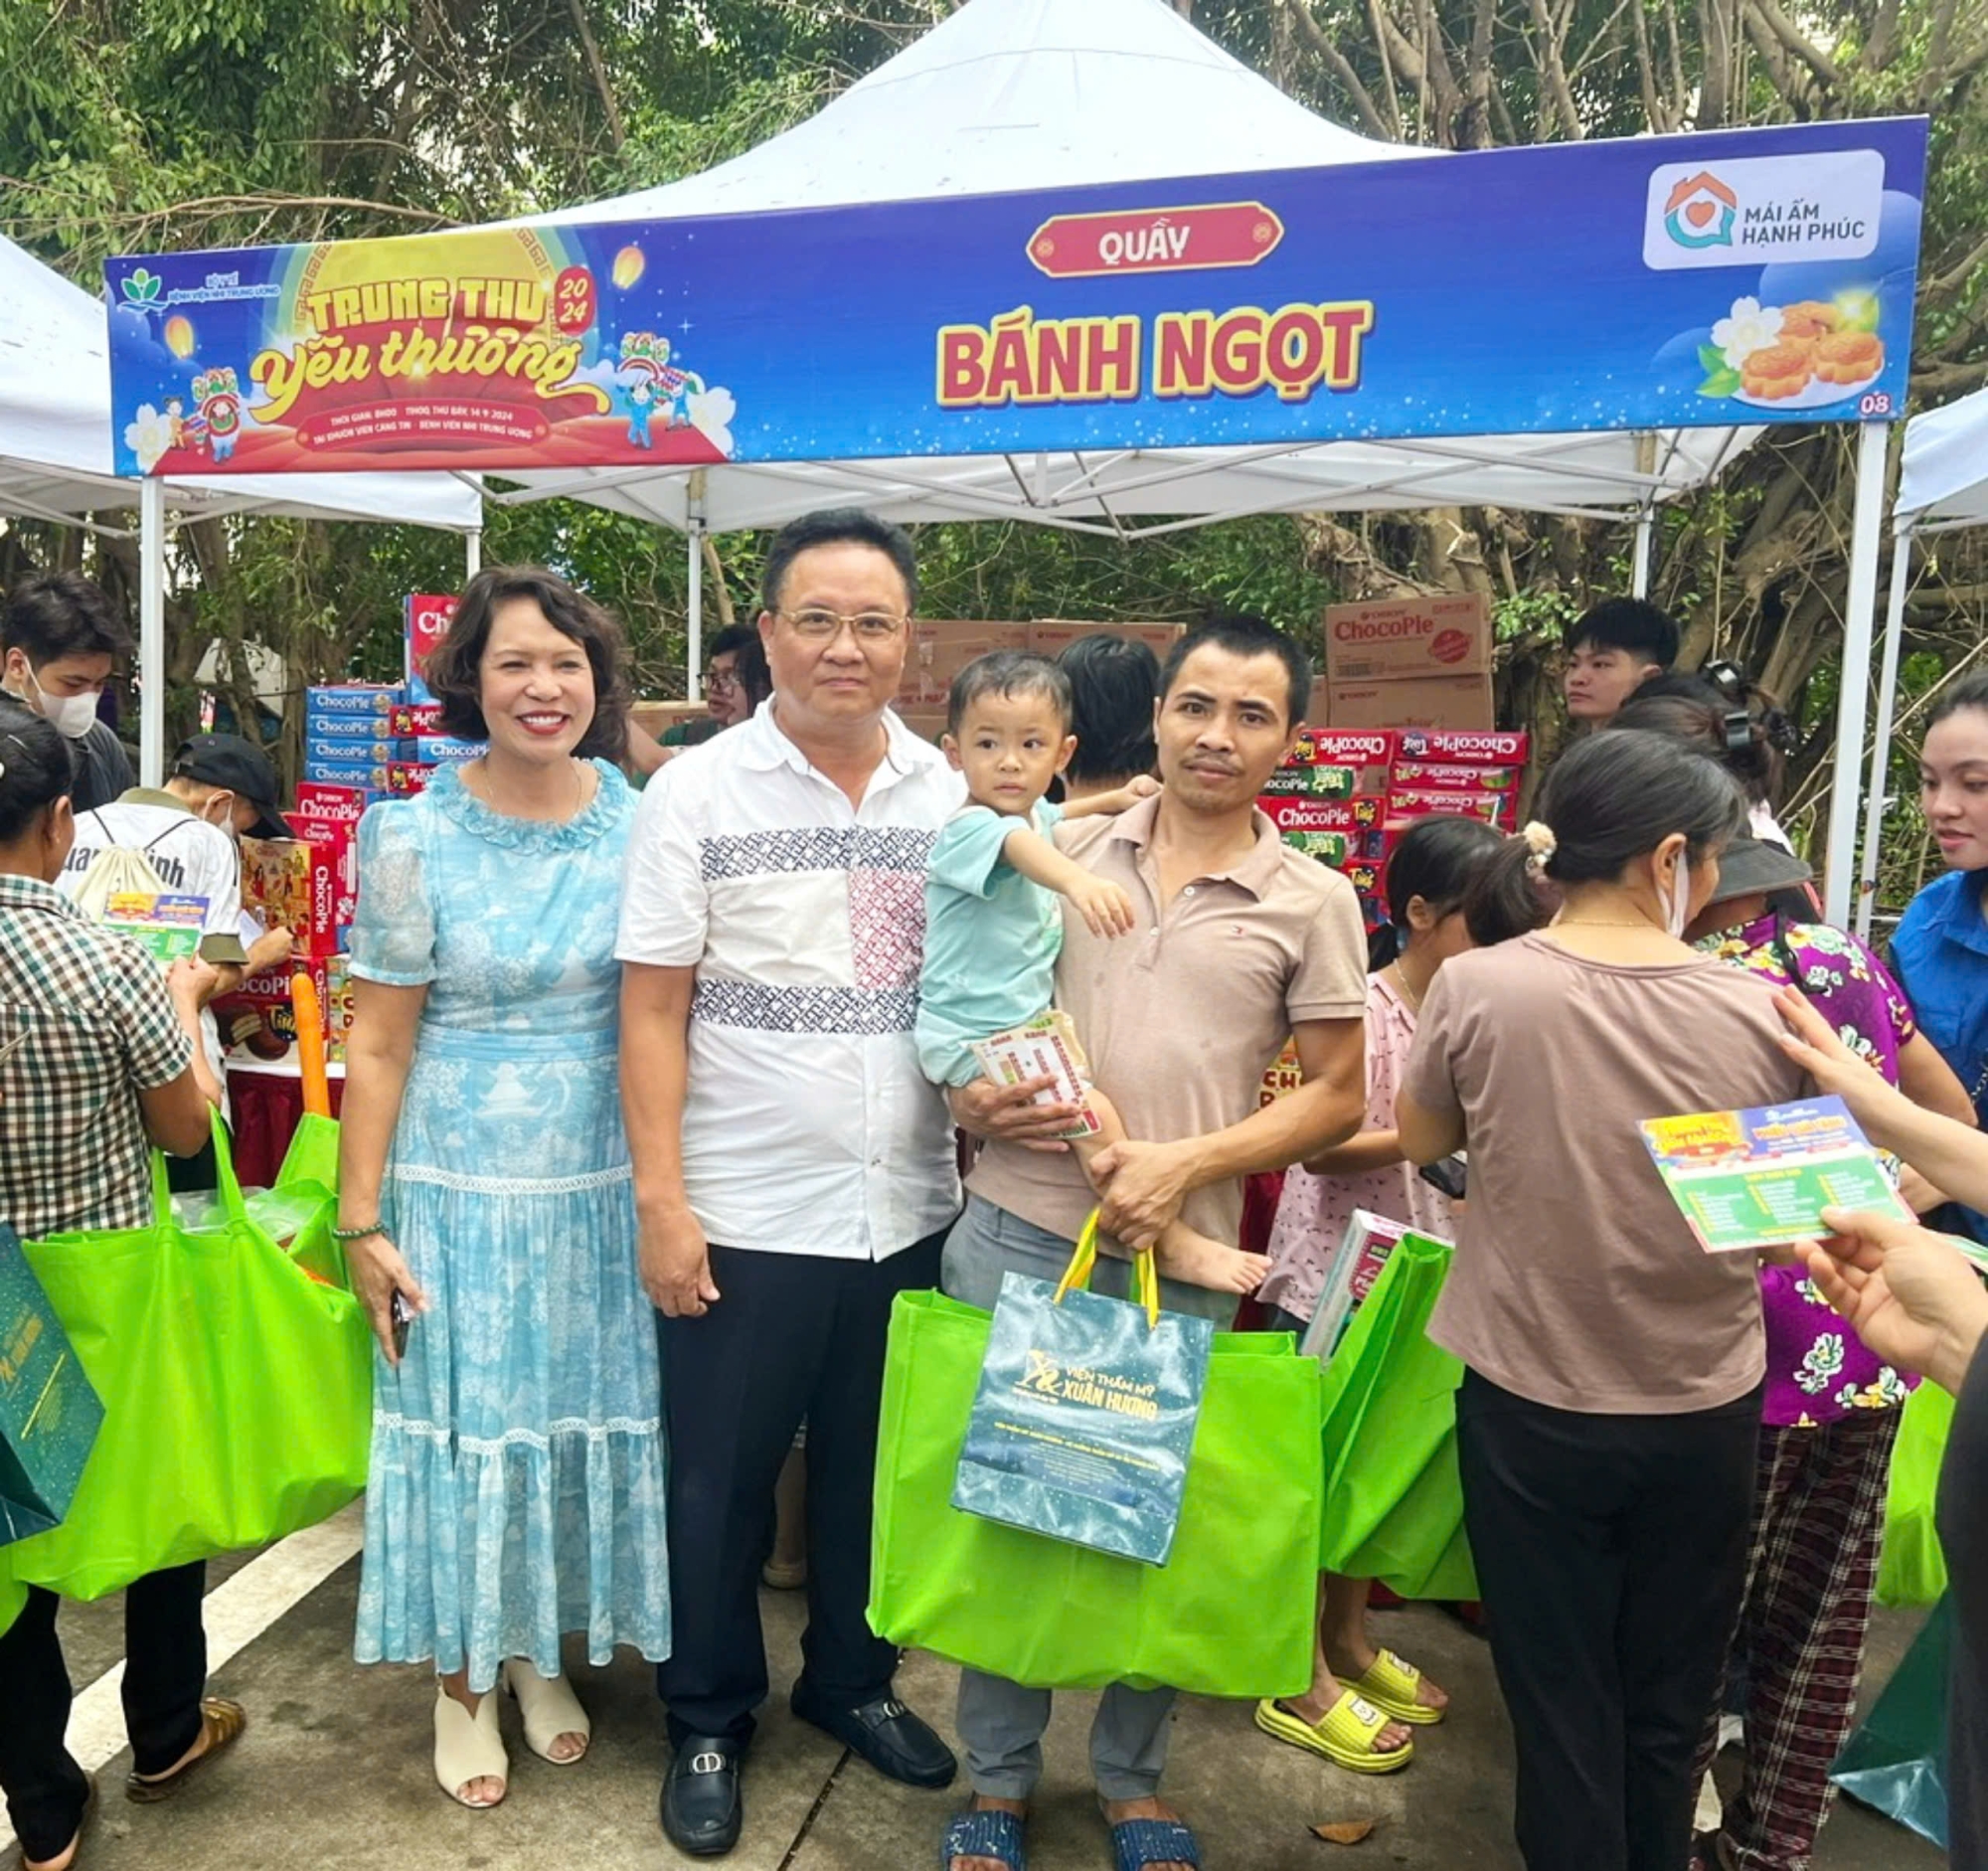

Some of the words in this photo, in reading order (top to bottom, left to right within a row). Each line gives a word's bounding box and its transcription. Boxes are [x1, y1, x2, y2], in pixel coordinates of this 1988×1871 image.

[1743, 202, 1782, 224] MÁI
[1788, 198, 1820, 220] ẤM
[1098, 217, 1191, 264] QUẦY
[1741, 224, 1801, 249] HẠNH
[1807, 216, 1865, 242] PHÚC
[560, 277, 587, 298] 20
[307, 277, 449, 332] TRUNG
[457, 278, 546, 323] THU
[560, 301, 586, 324] 24
[937, 305, 1140, 404] BÁNH
[1154, 301, 1373, 400] NGỌT
[1334, 614, 1433, 641] ChocoPie
[316, 694, 369, 709] ChocoPie
[316, 720, 368, 734] ChocoPie
[316, 744, 367, 758] ChocoPie
[1320, 737, 1386, 754] ChocoPie
[1433, 736, 1517, 754] ChocoPie
[316, 768, 367, 781] ChocoPie
[1278, 807, 1350, 826] ChocoPie
[315, 866, 329, 934] ChocoPie
